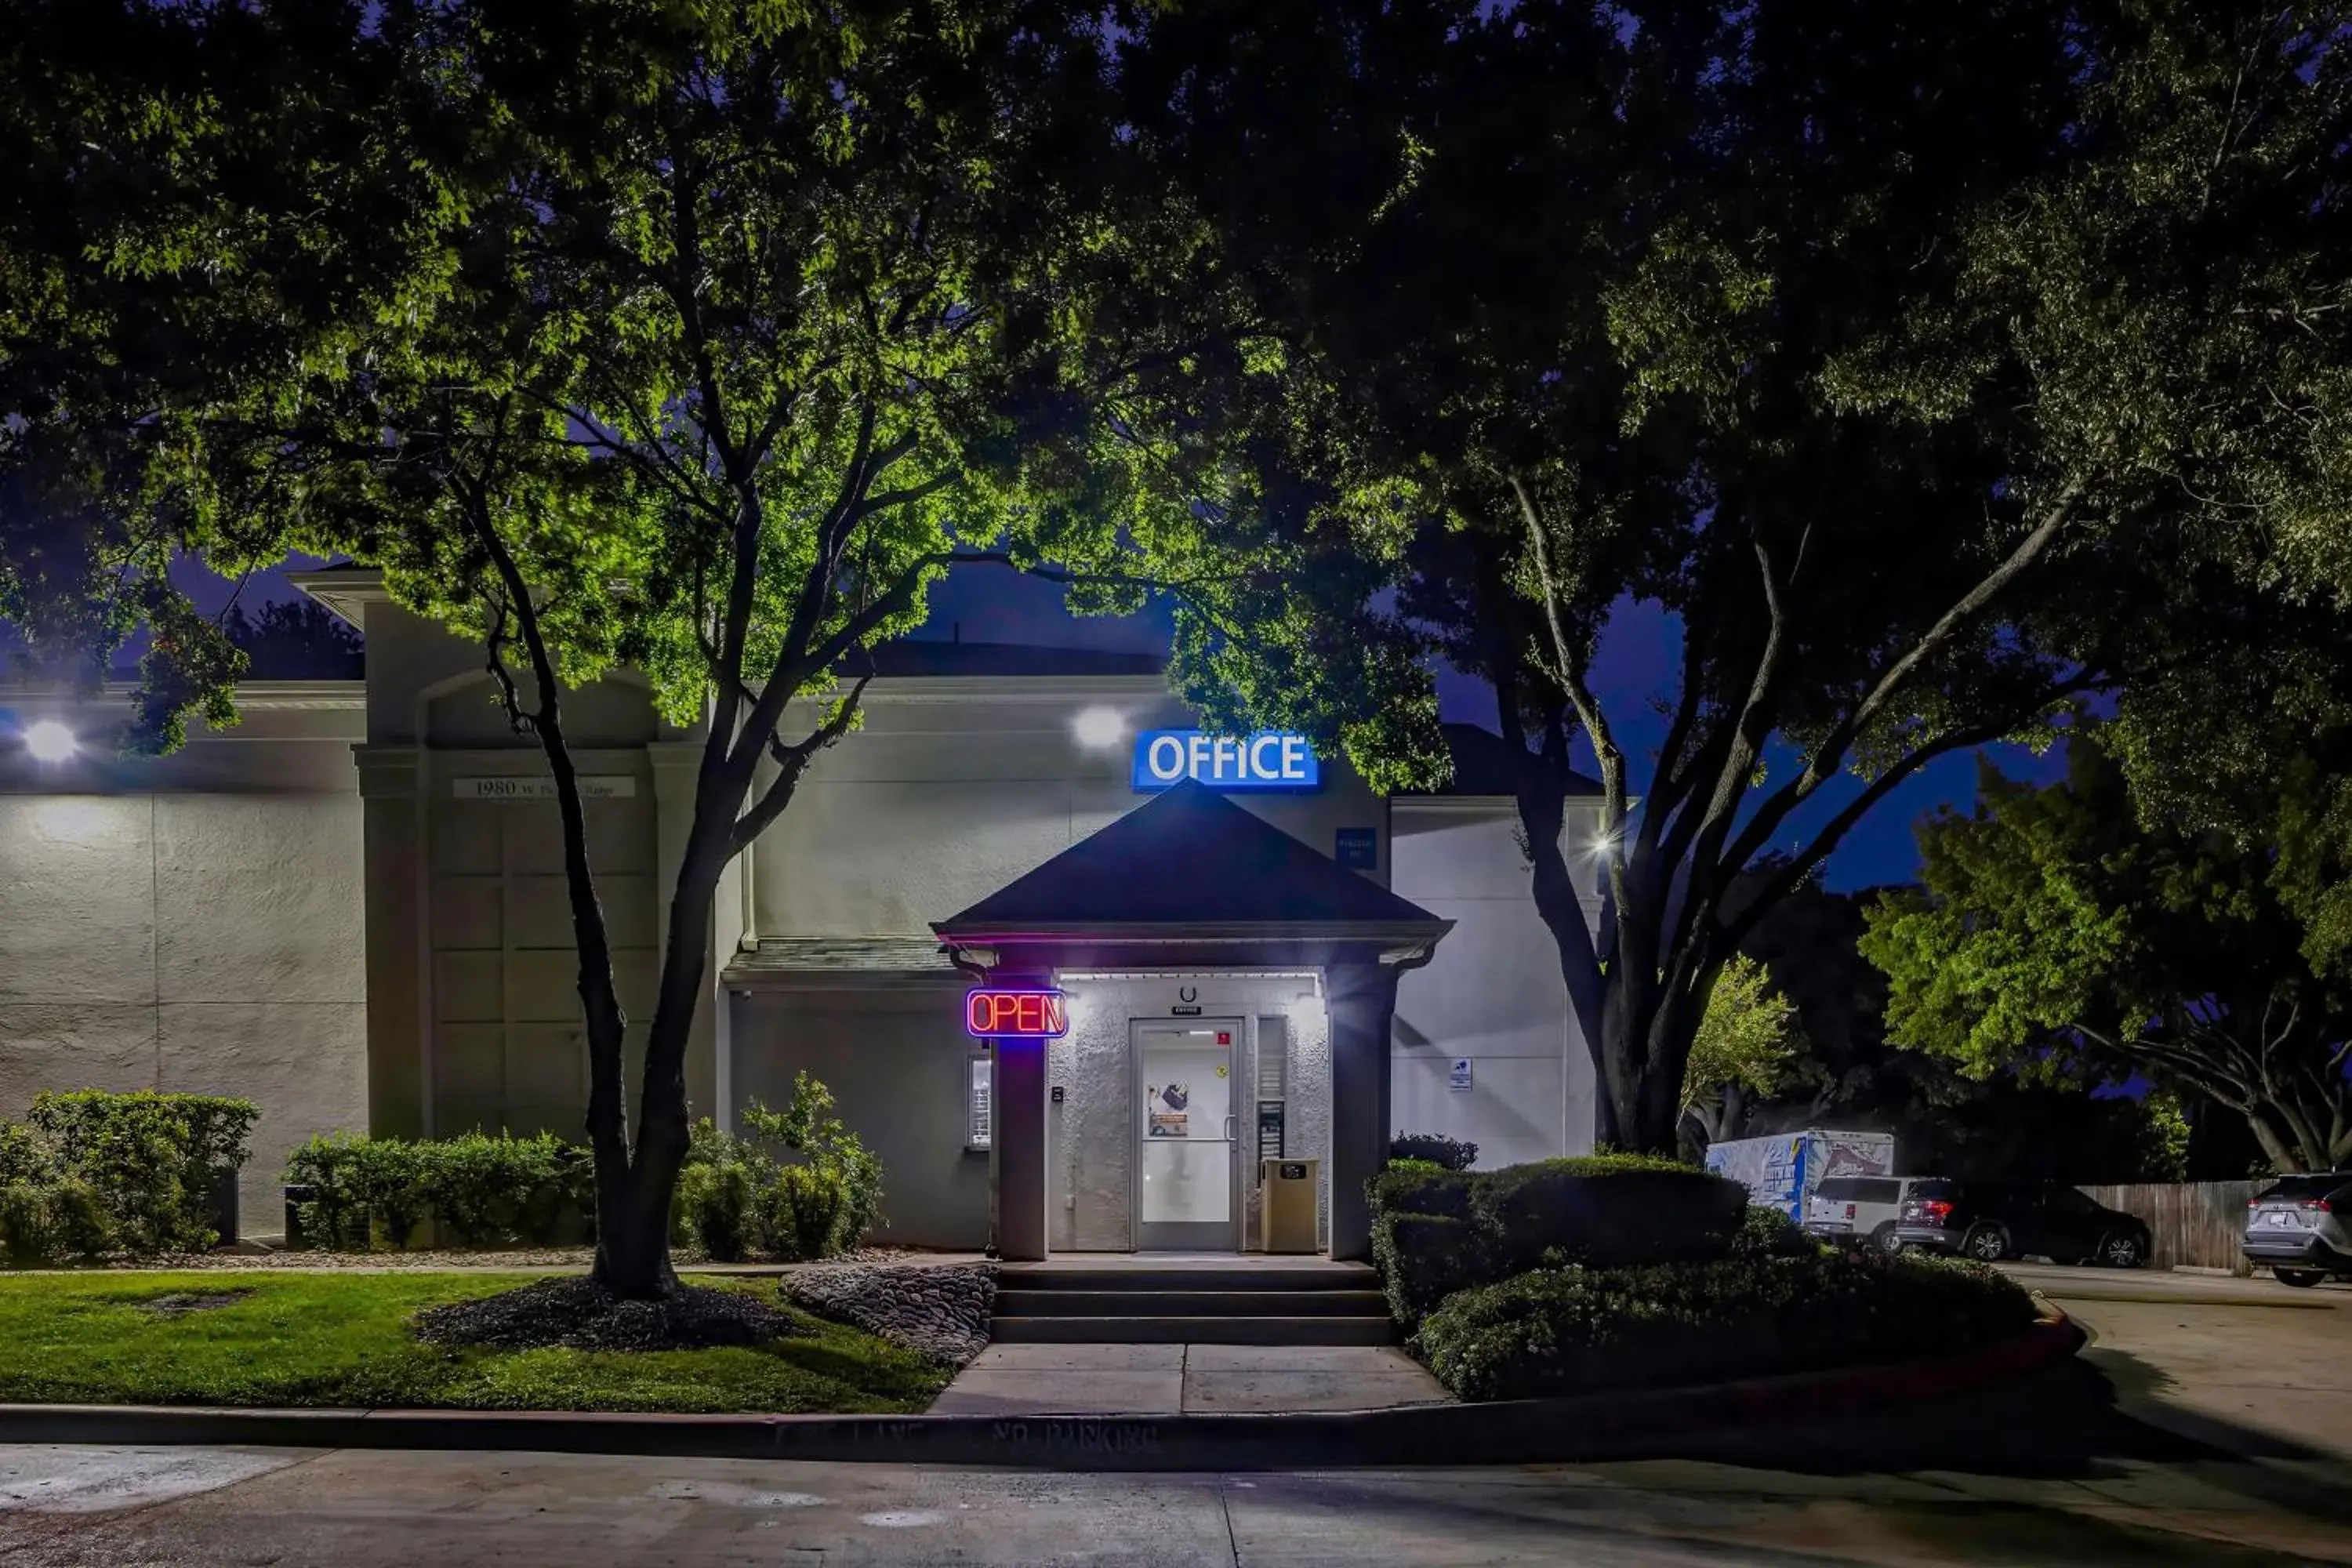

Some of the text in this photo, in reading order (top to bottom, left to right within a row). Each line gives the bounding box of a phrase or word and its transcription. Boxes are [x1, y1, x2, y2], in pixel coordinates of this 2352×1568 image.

[1149, 735, 1305, 779] OFFICE
[477, 780, 516, 797] 1980
[971, 994, 1064, 1032] OPEN
